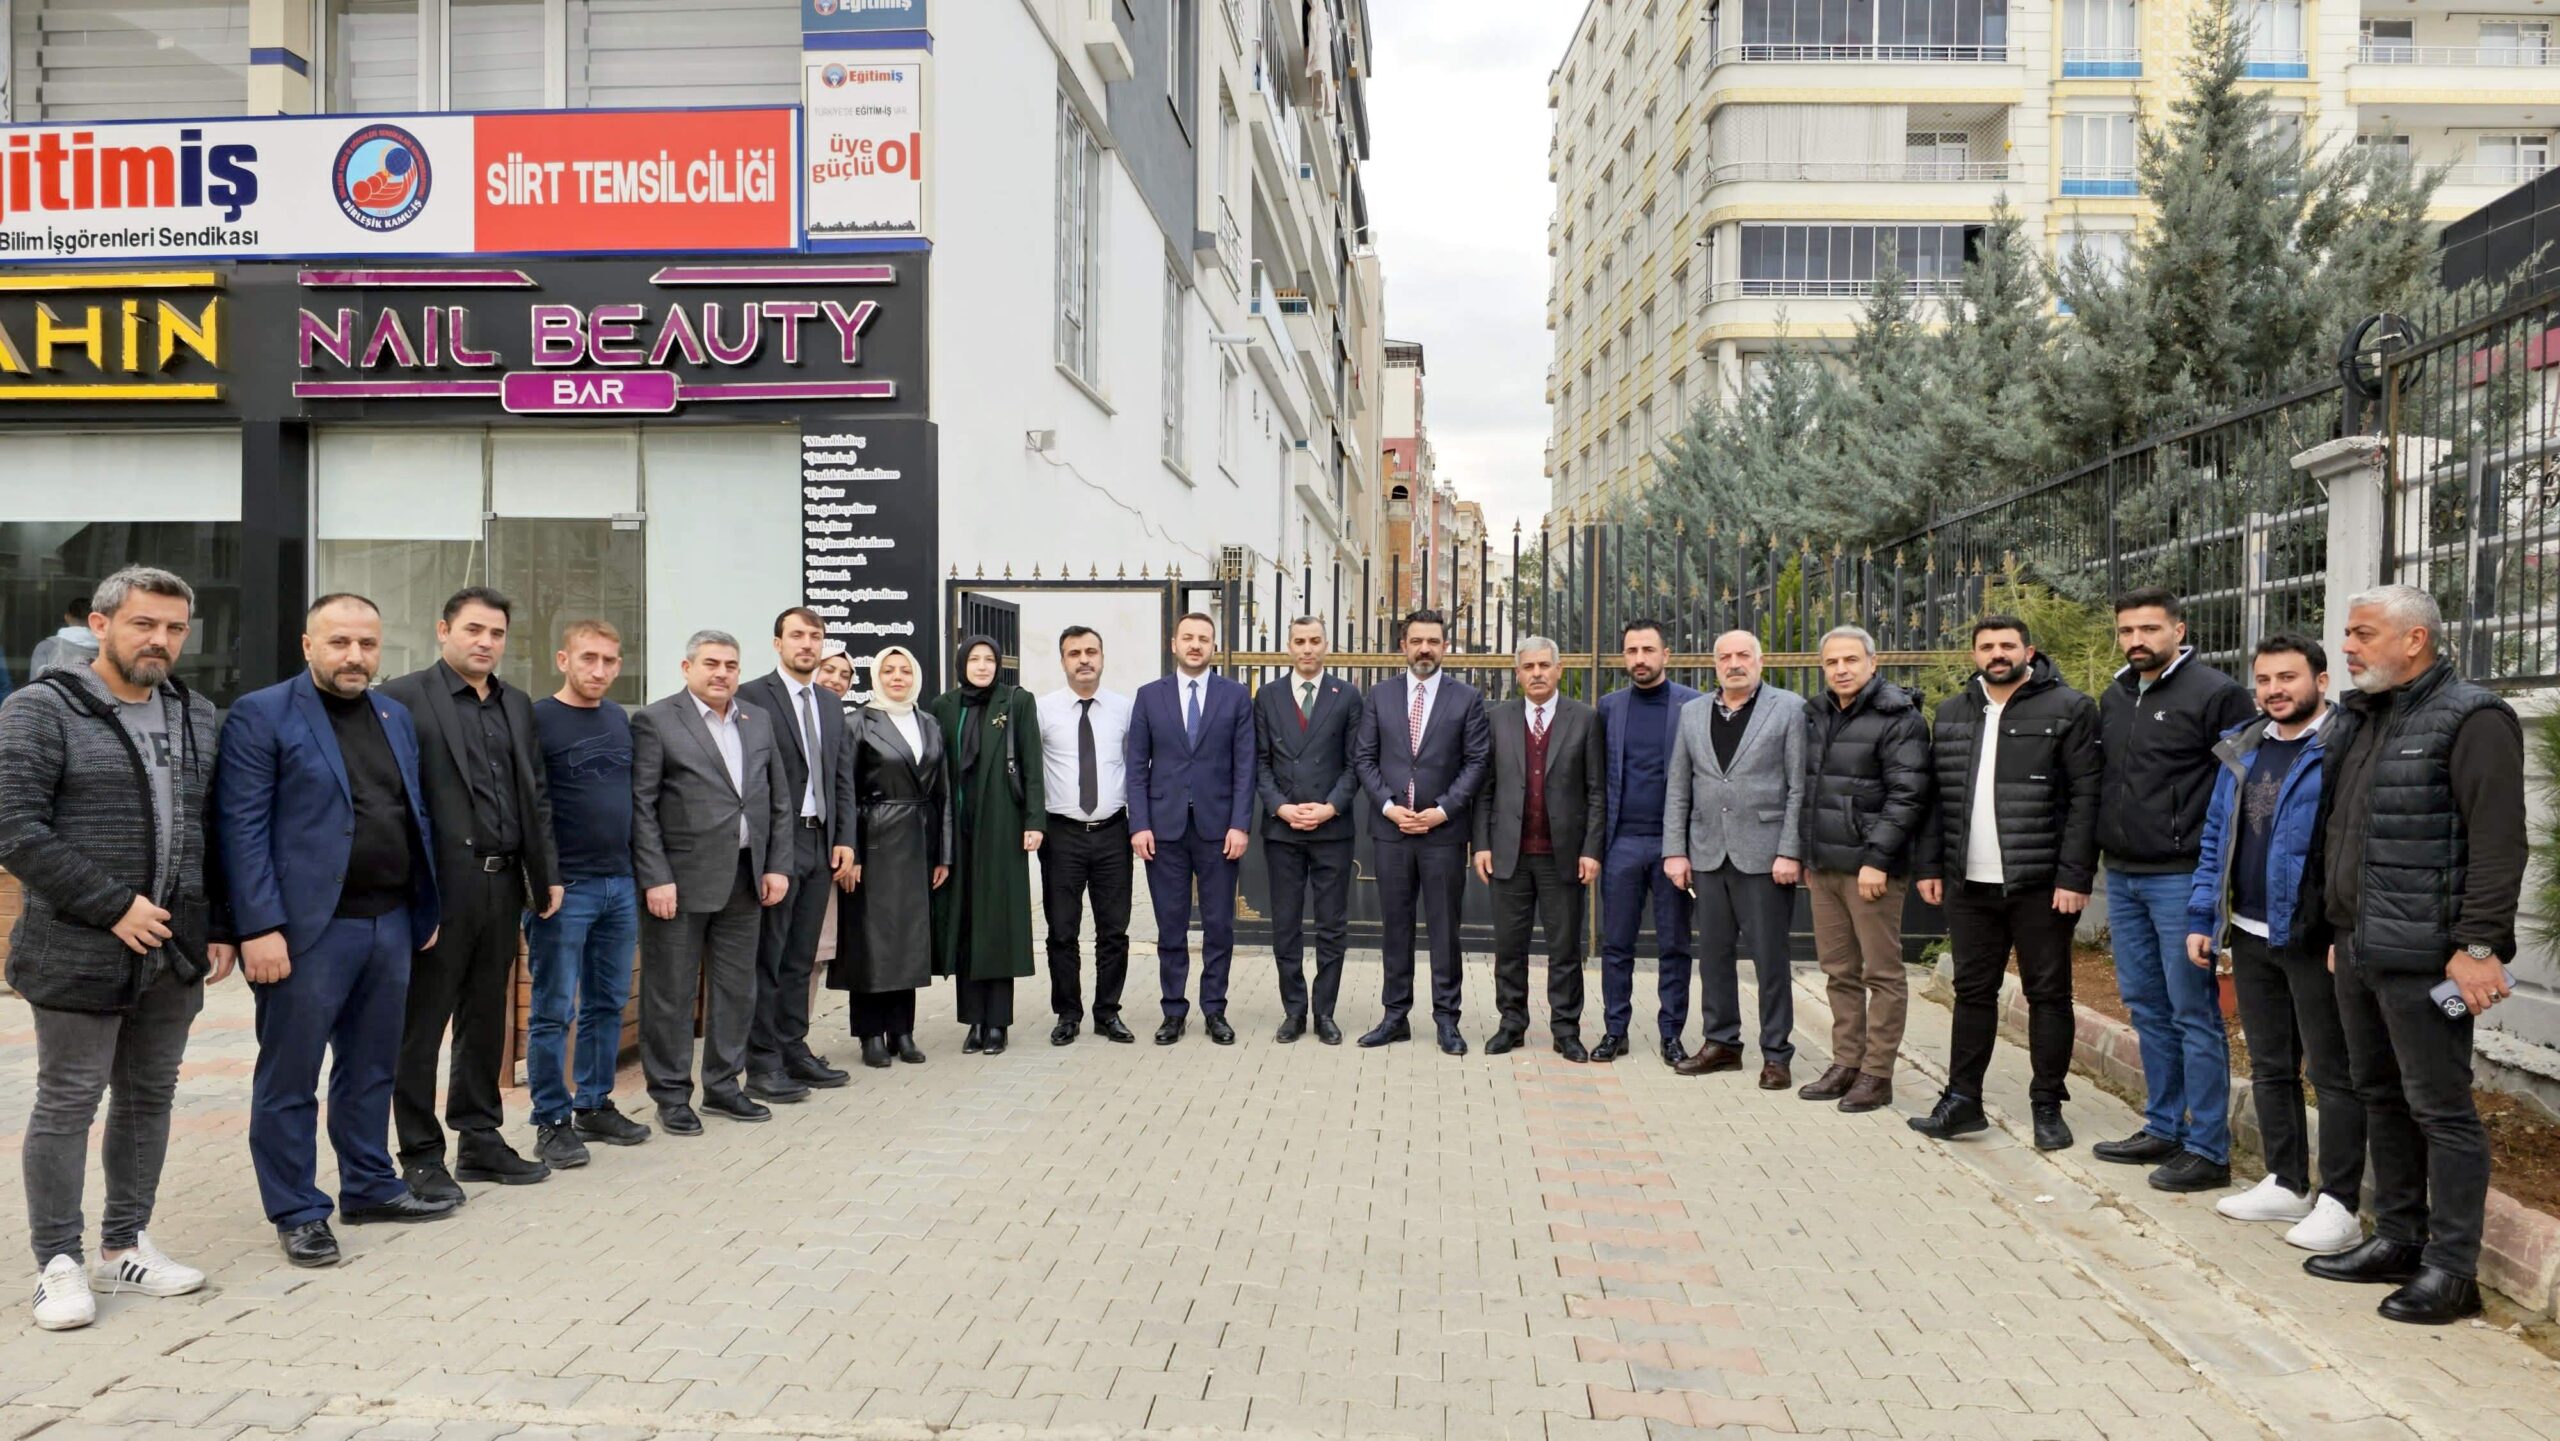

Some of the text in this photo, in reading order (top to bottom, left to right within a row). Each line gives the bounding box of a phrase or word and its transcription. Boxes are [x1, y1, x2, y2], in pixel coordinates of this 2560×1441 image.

[855, 105, 892, 117] EĞİTİM-İŞ
[830, 133, 873, 158] üye
[877, 132, 920, 181] ol
[0, 129, 258, 225] itimiş
[486, 152, 565, 205] SİİRT
[572, 148, 776, 204] TEMSİLCİLİĞİ
[812, 156, 875, 184] güçlü
[342, 199, 423, 229] BİRLEŞİK KAMU-İŞ
[0, 226, 259, 255] Bilim İşgörenleri Sendikası
[298, 300, 880, 369] NAIL BEAUTY
[553, 379, 625, 405] BAR
